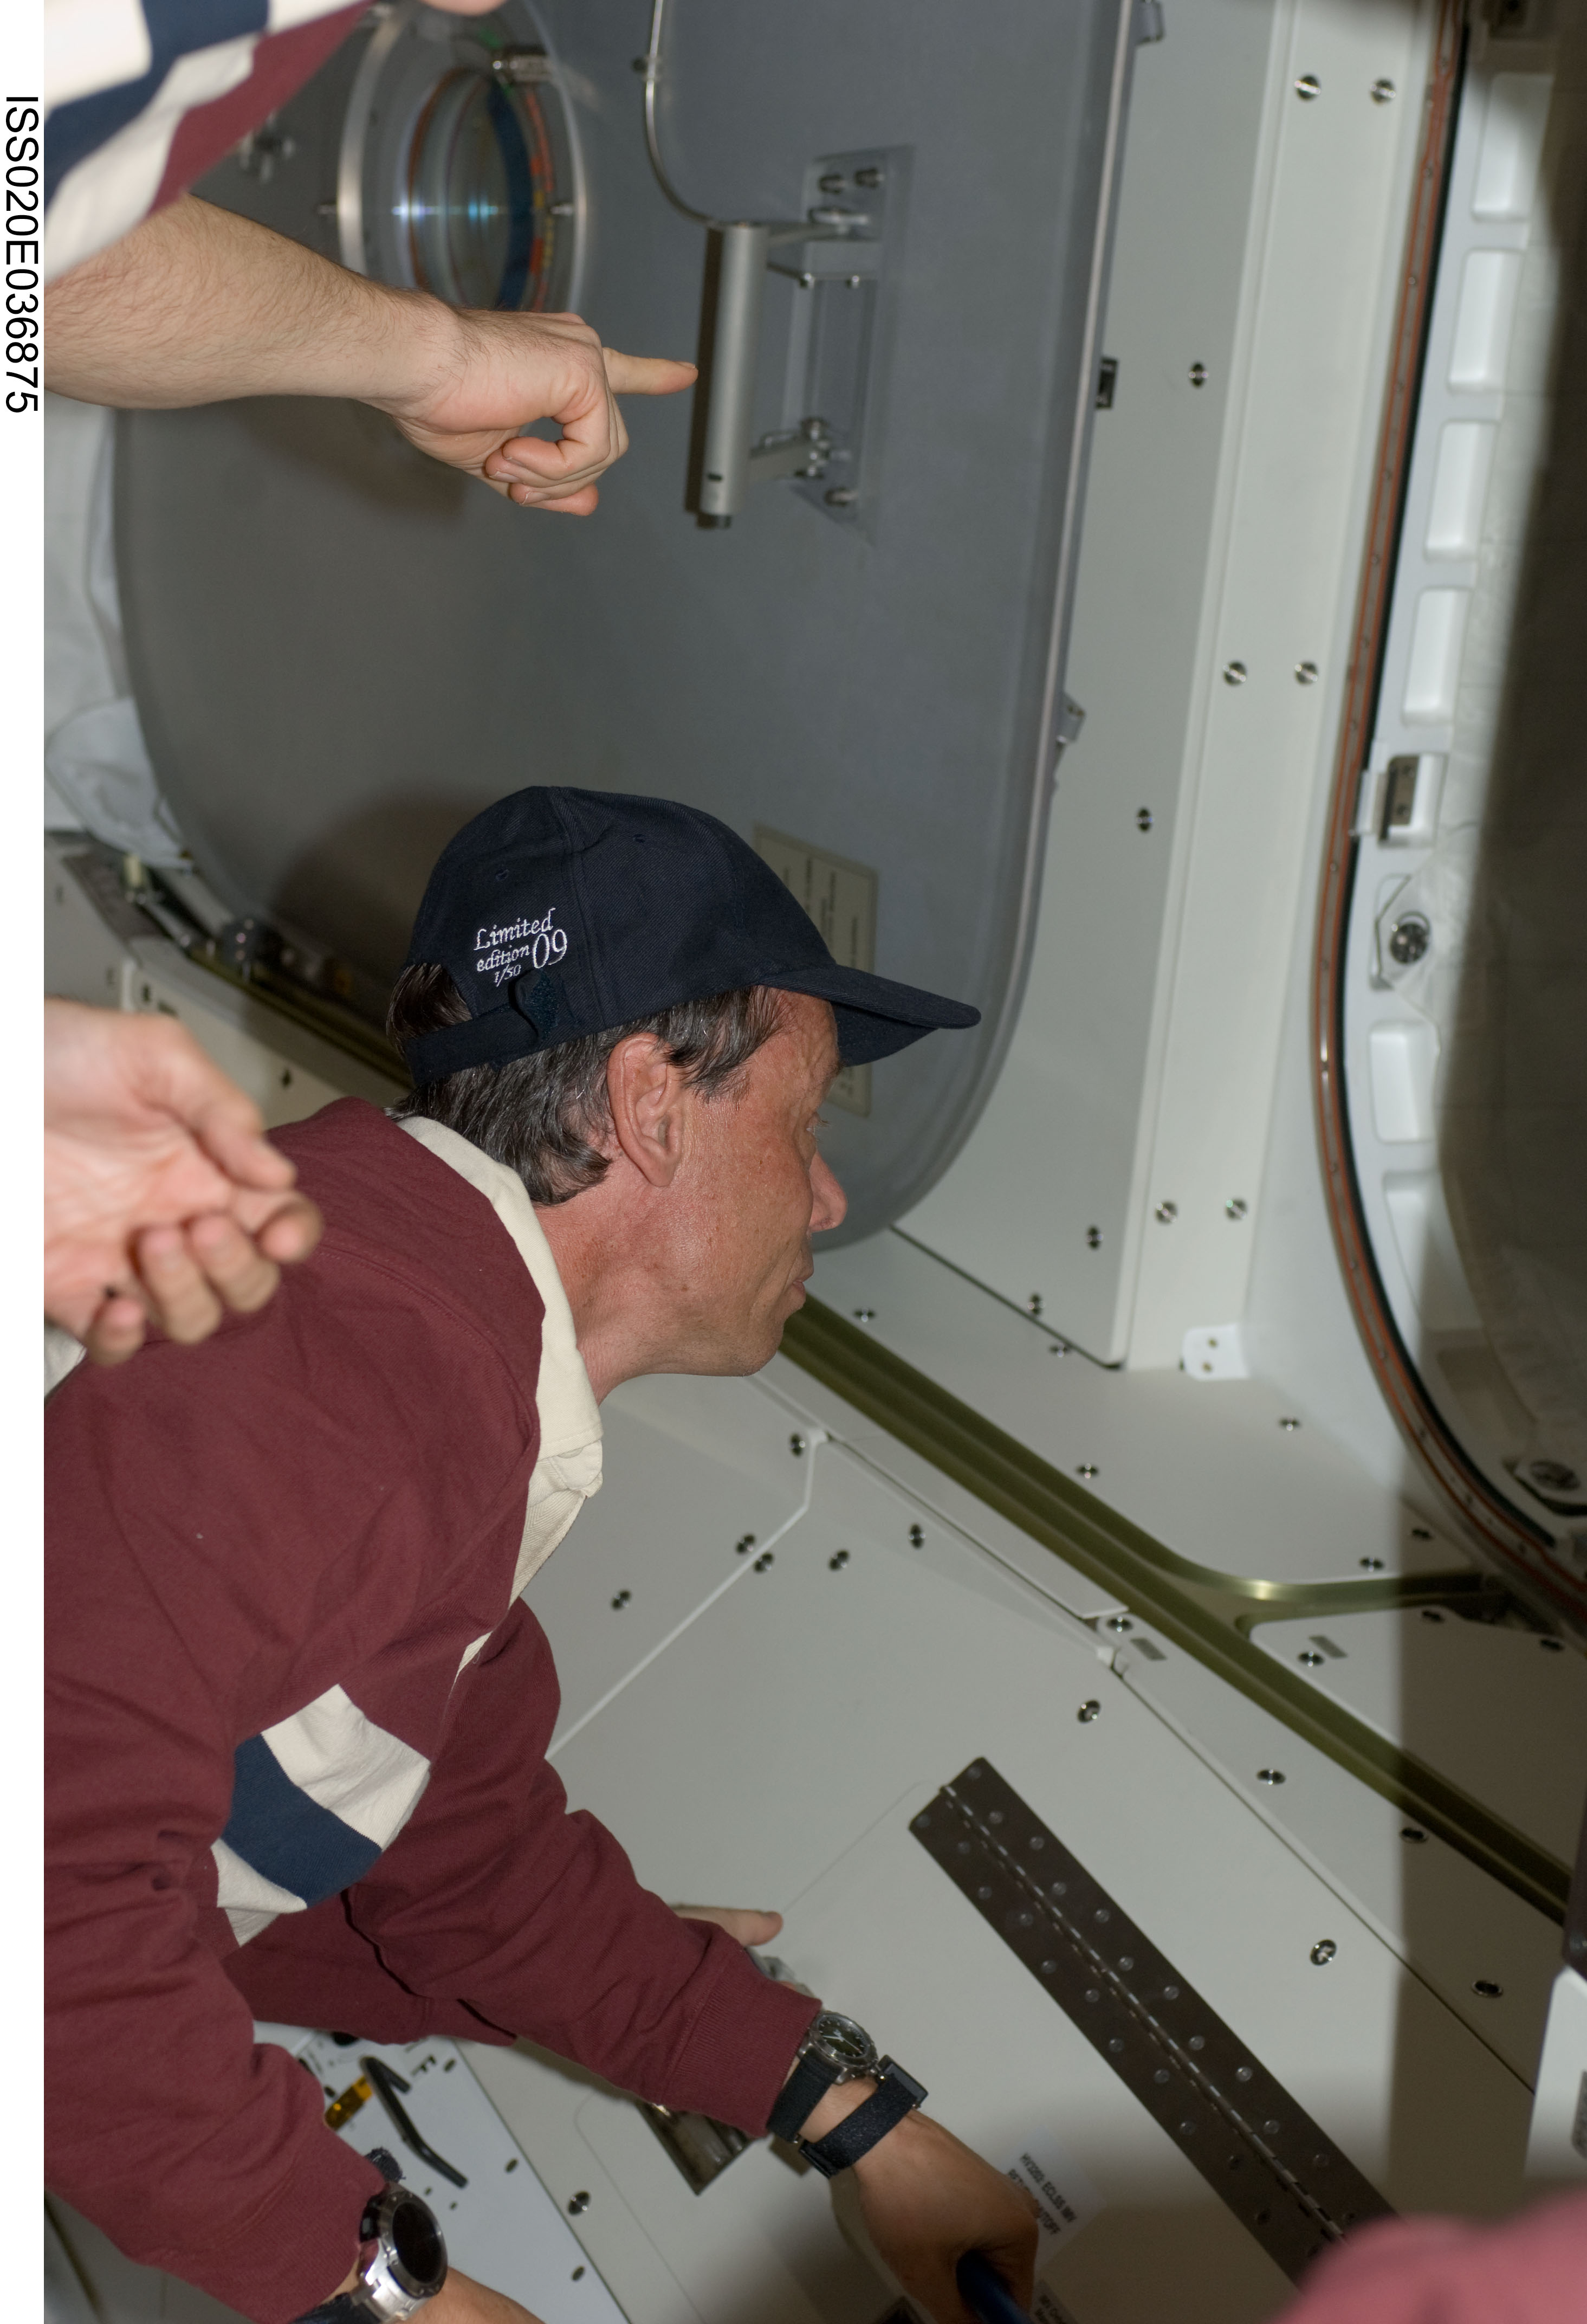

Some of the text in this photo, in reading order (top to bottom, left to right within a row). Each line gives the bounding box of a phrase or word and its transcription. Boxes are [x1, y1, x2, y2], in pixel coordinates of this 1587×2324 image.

[473, 907, 556, 951] Limited
[477, 929, 568, 972] edition 09
[494, 964, 522, 987] 1/50
